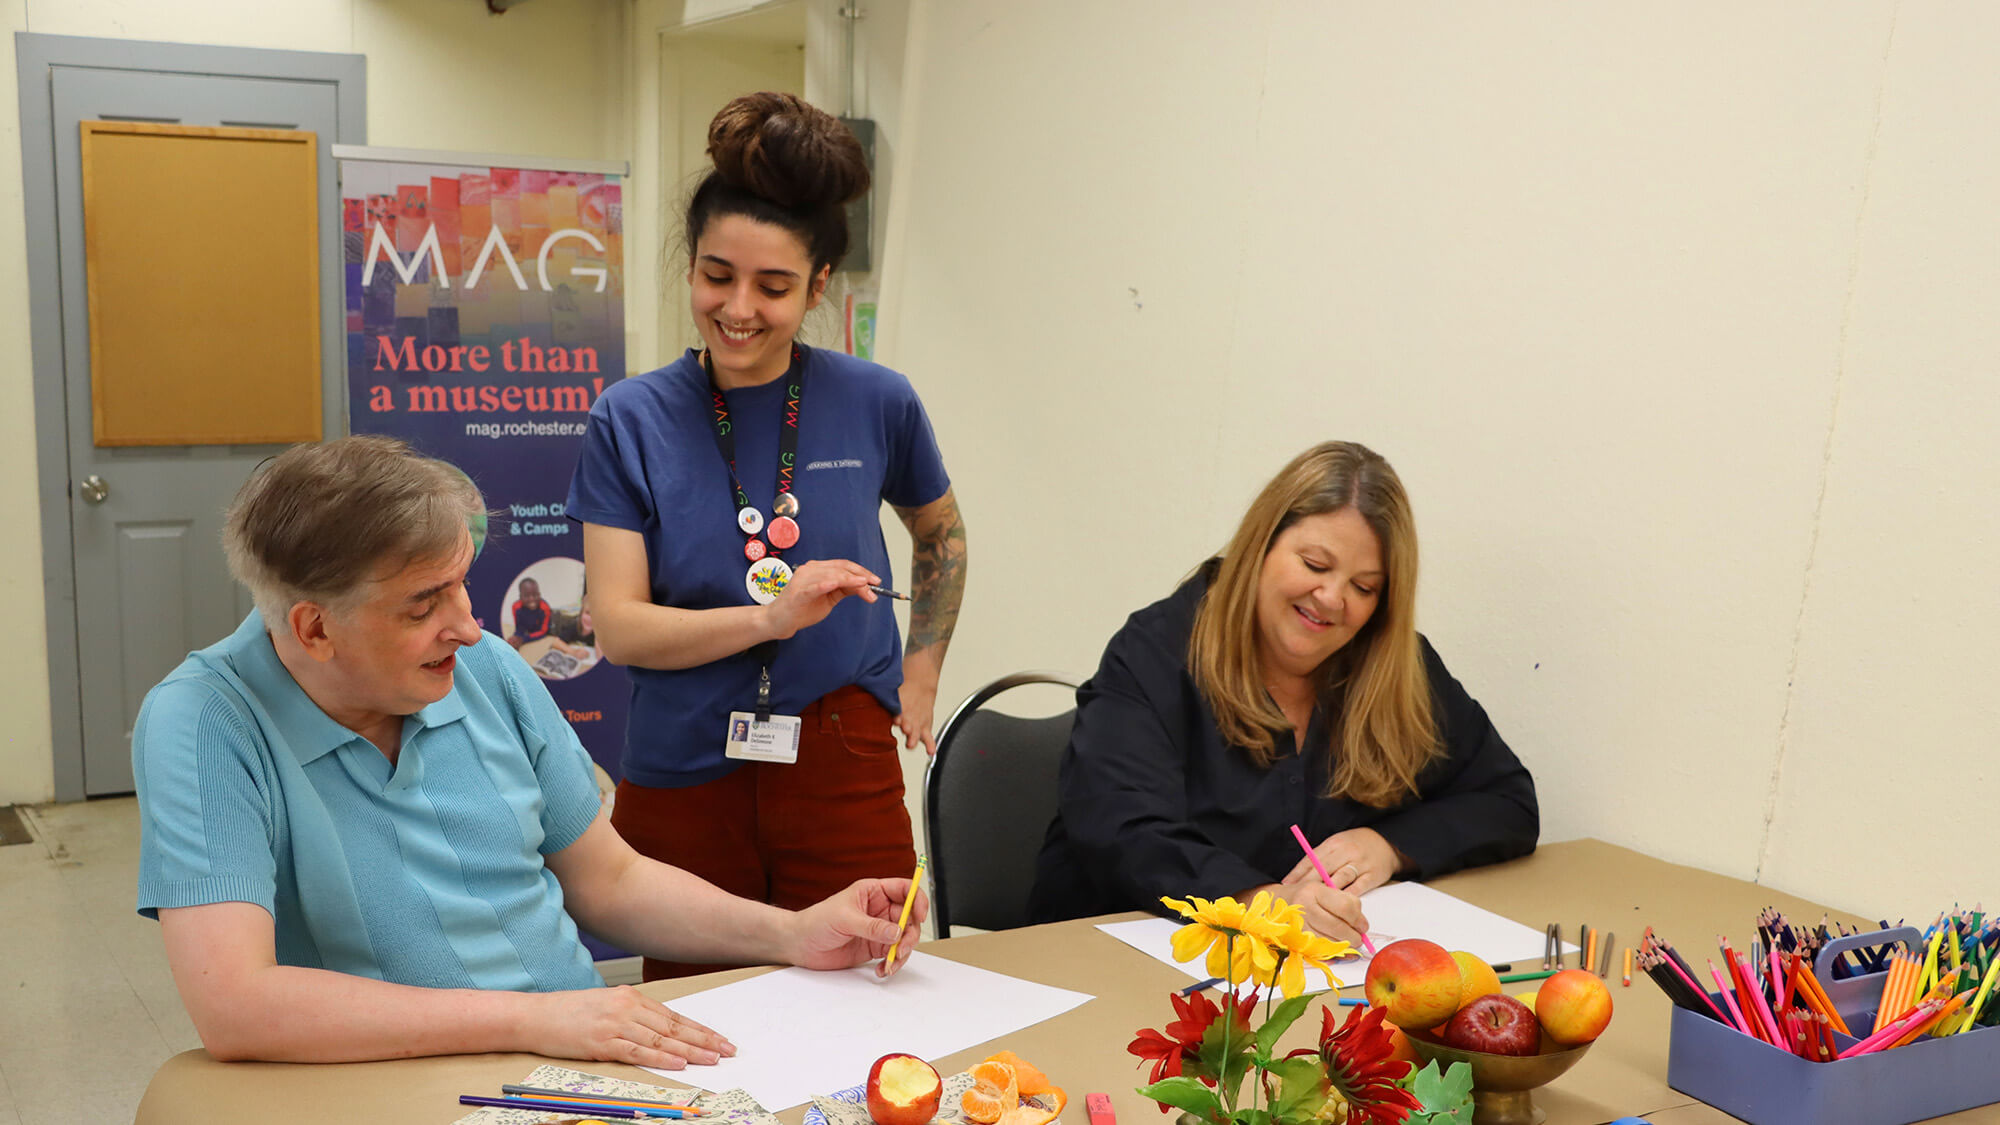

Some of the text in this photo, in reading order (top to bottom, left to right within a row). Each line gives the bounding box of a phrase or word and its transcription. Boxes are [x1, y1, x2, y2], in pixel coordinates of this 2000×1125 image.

[362, 221, 607, 292] MAG
[374, 335, 600, 373] More than
[369, 385, 395, 412] a
[713, 392, 732, 436] MAG
[786, 384, 800, 428] MAG
[780, 452, 794, 494] MAG
[510, 503, 548, 517] Youth
[511, 522, 569, 537] & Camps
[565, 709, 603, 722] Tours
